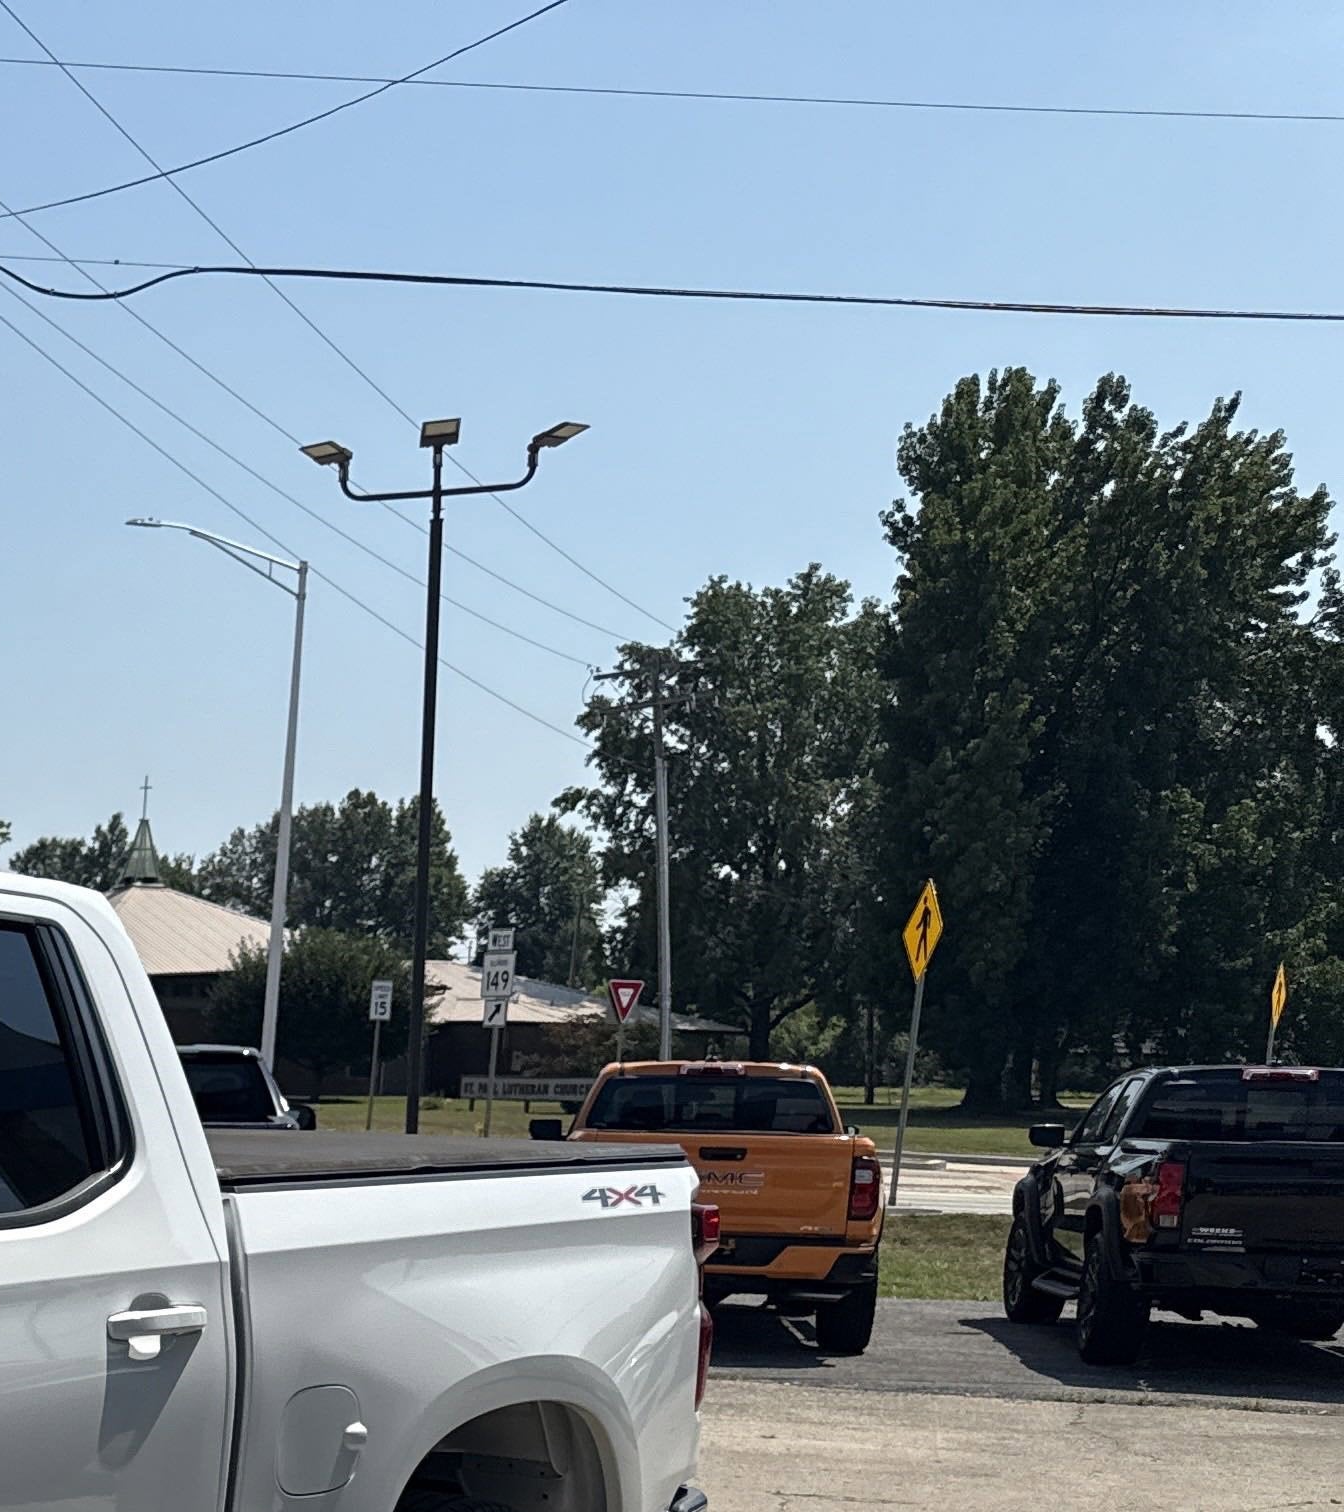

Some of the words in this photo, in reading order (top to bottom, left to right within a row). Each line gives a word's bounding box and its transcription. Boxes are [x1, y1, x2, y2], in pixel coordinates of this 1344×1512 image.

[492, 934, 511, 947] WEST
[486, 970, 510, 991] 149
[374, 1001, 387, 1016] 15
[478, 1082, 499, 1094] PAL
[502, 1081, 550, 1095] LUTHERAN
